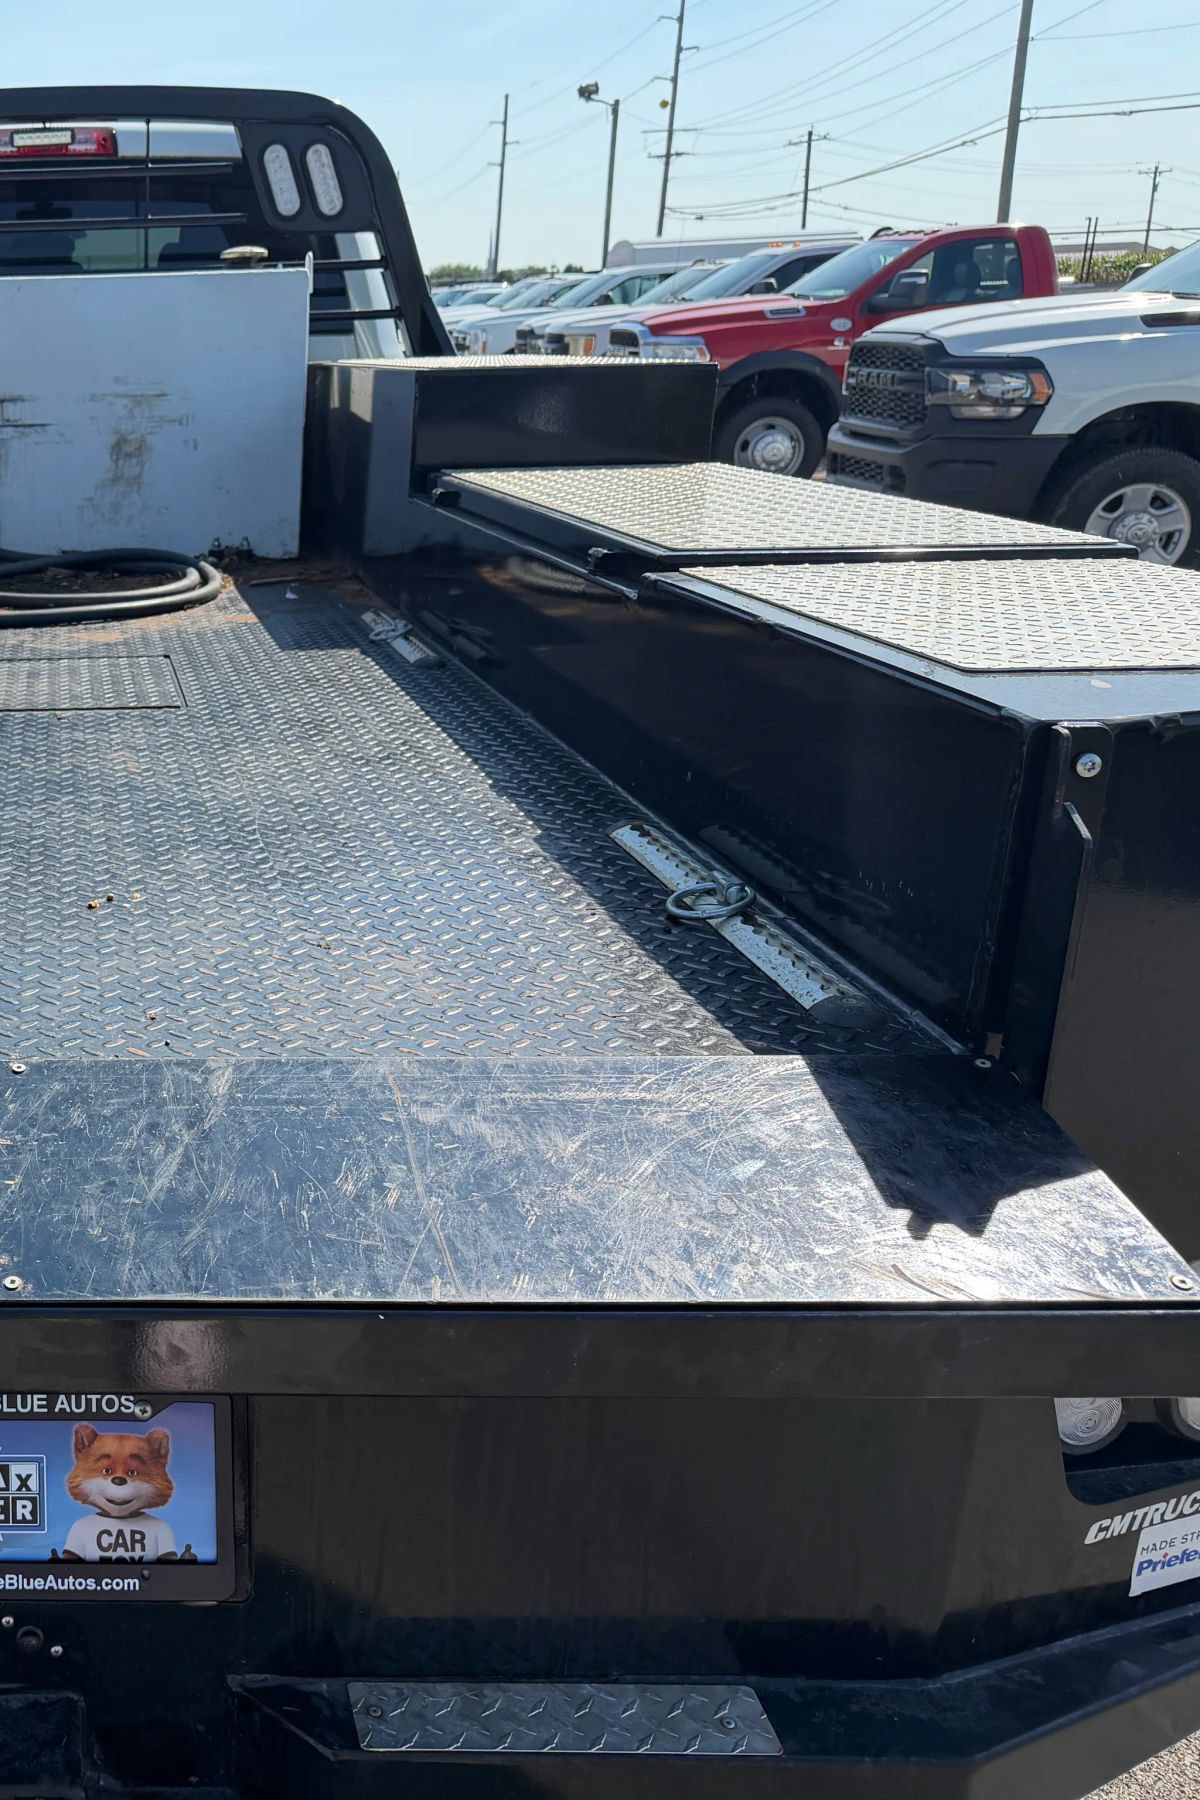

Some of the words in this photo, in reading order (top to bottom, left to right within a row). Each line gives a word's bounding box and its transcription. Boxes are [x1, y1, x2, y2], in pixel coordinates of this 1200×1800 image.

[858, 371, 897, 386] RAM
[54, 1394, 135, 1413] AUTOS
[1084, 1490, 1200, 1545] CMTRUC
[96, 1528, 146, 1553] CAR
[1141, 1536, 1178, 1556] MADE
[1136, 1548, 1200, 1577] Priefe
